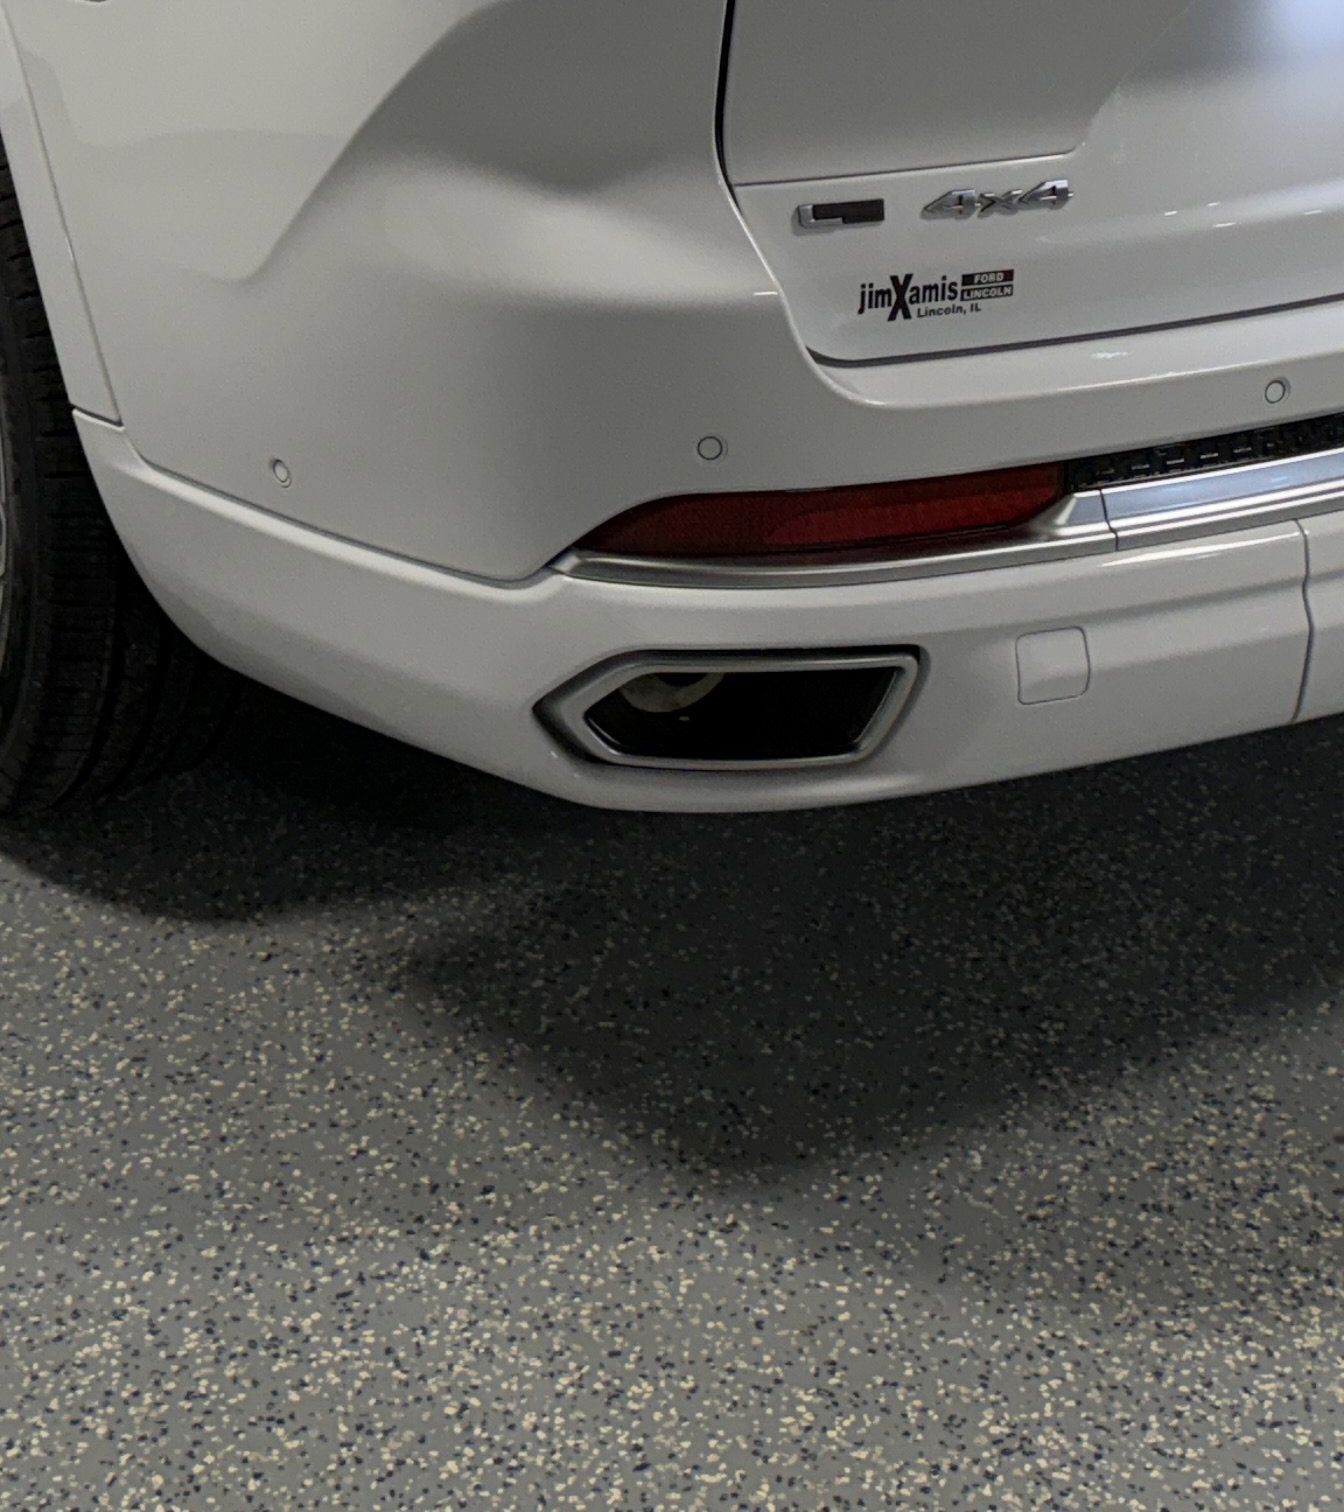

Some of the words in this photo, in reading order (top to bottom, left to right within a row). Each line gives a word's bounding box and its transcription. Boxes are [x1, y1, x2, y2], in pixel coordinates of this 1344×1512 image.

[974, 272, 1005, 284] FORD
[857, 273, 959, 322] jimXamis
[963, 285, 1012, 300] LINCOLN
[916, 303, 968, 319] Lincoln,
[969, 302, 982, 313] IL
